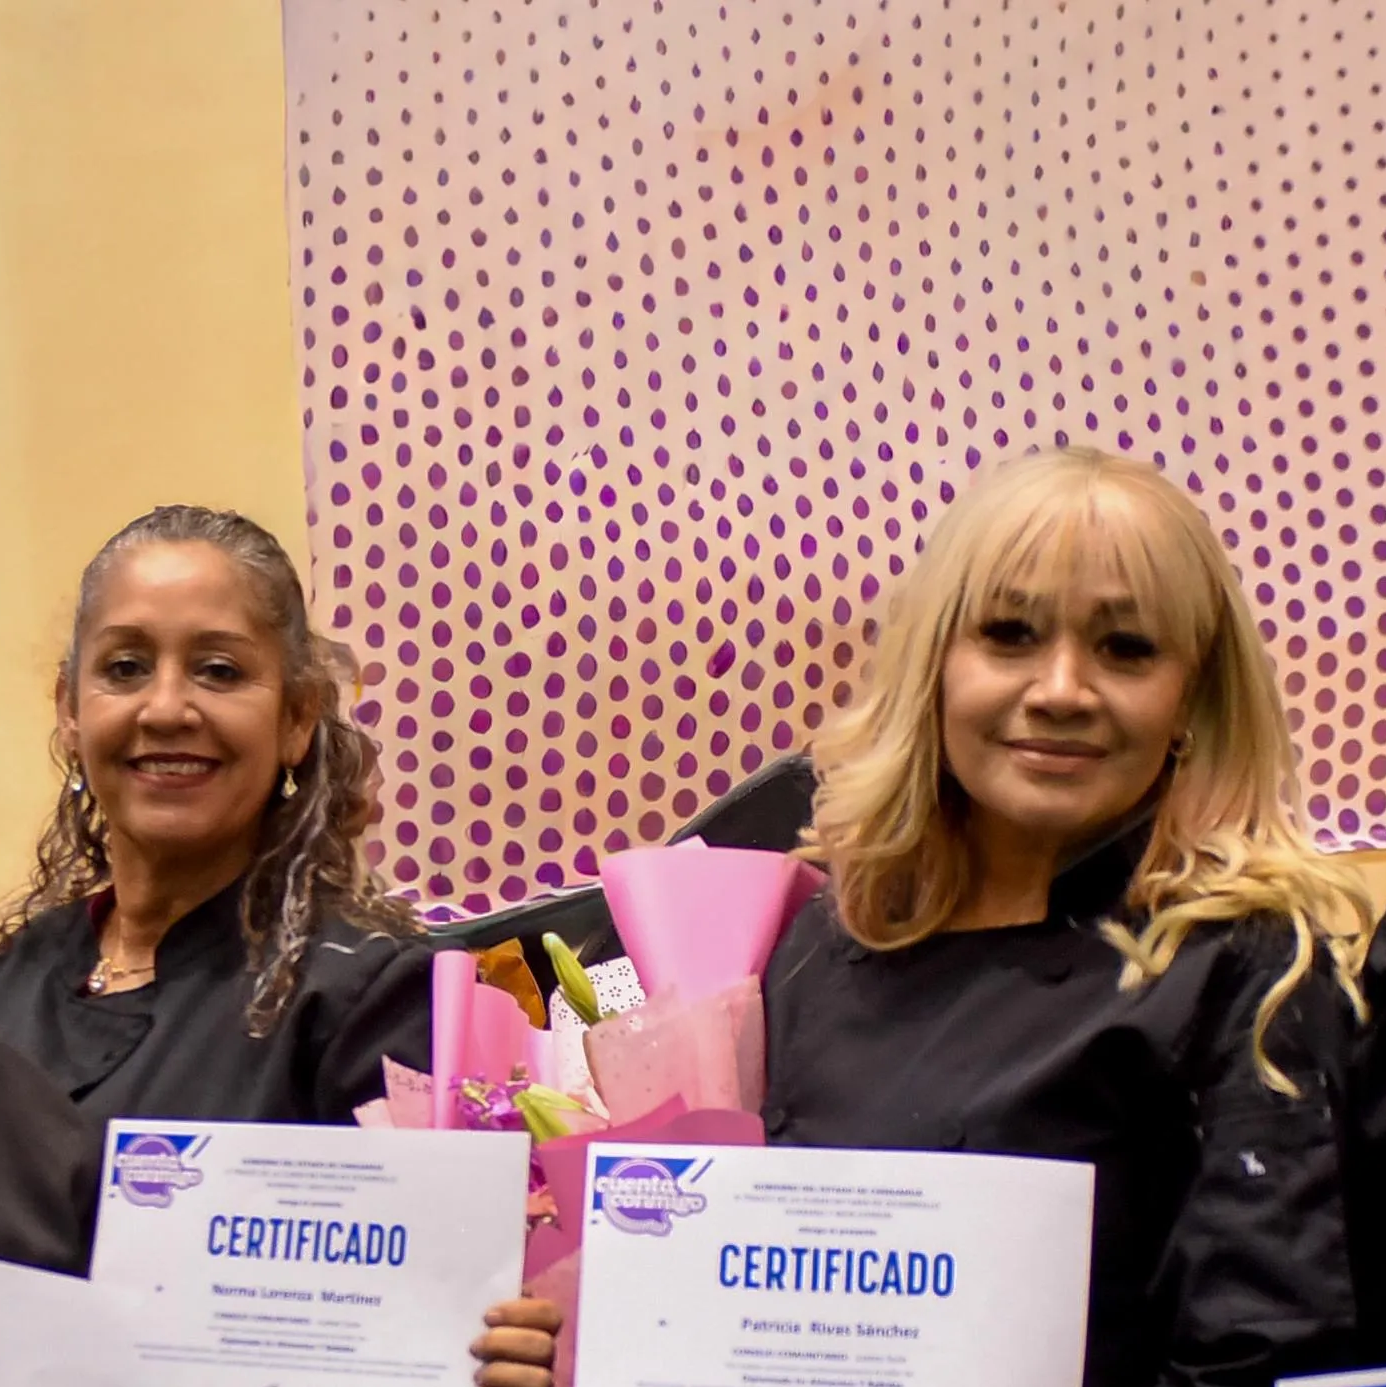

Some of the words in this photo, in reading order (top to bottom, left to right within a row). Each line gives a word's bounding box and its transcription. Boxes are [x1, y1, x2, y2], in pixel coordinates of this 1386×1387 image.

[207, 1214, 407, 1267] CERTIFICADO
[719, 1243, 956, 1297] CERTIFICADO
[741, 1317, 802, 1335] Patricia
[809, 1319, 851, 1337] Rivas
